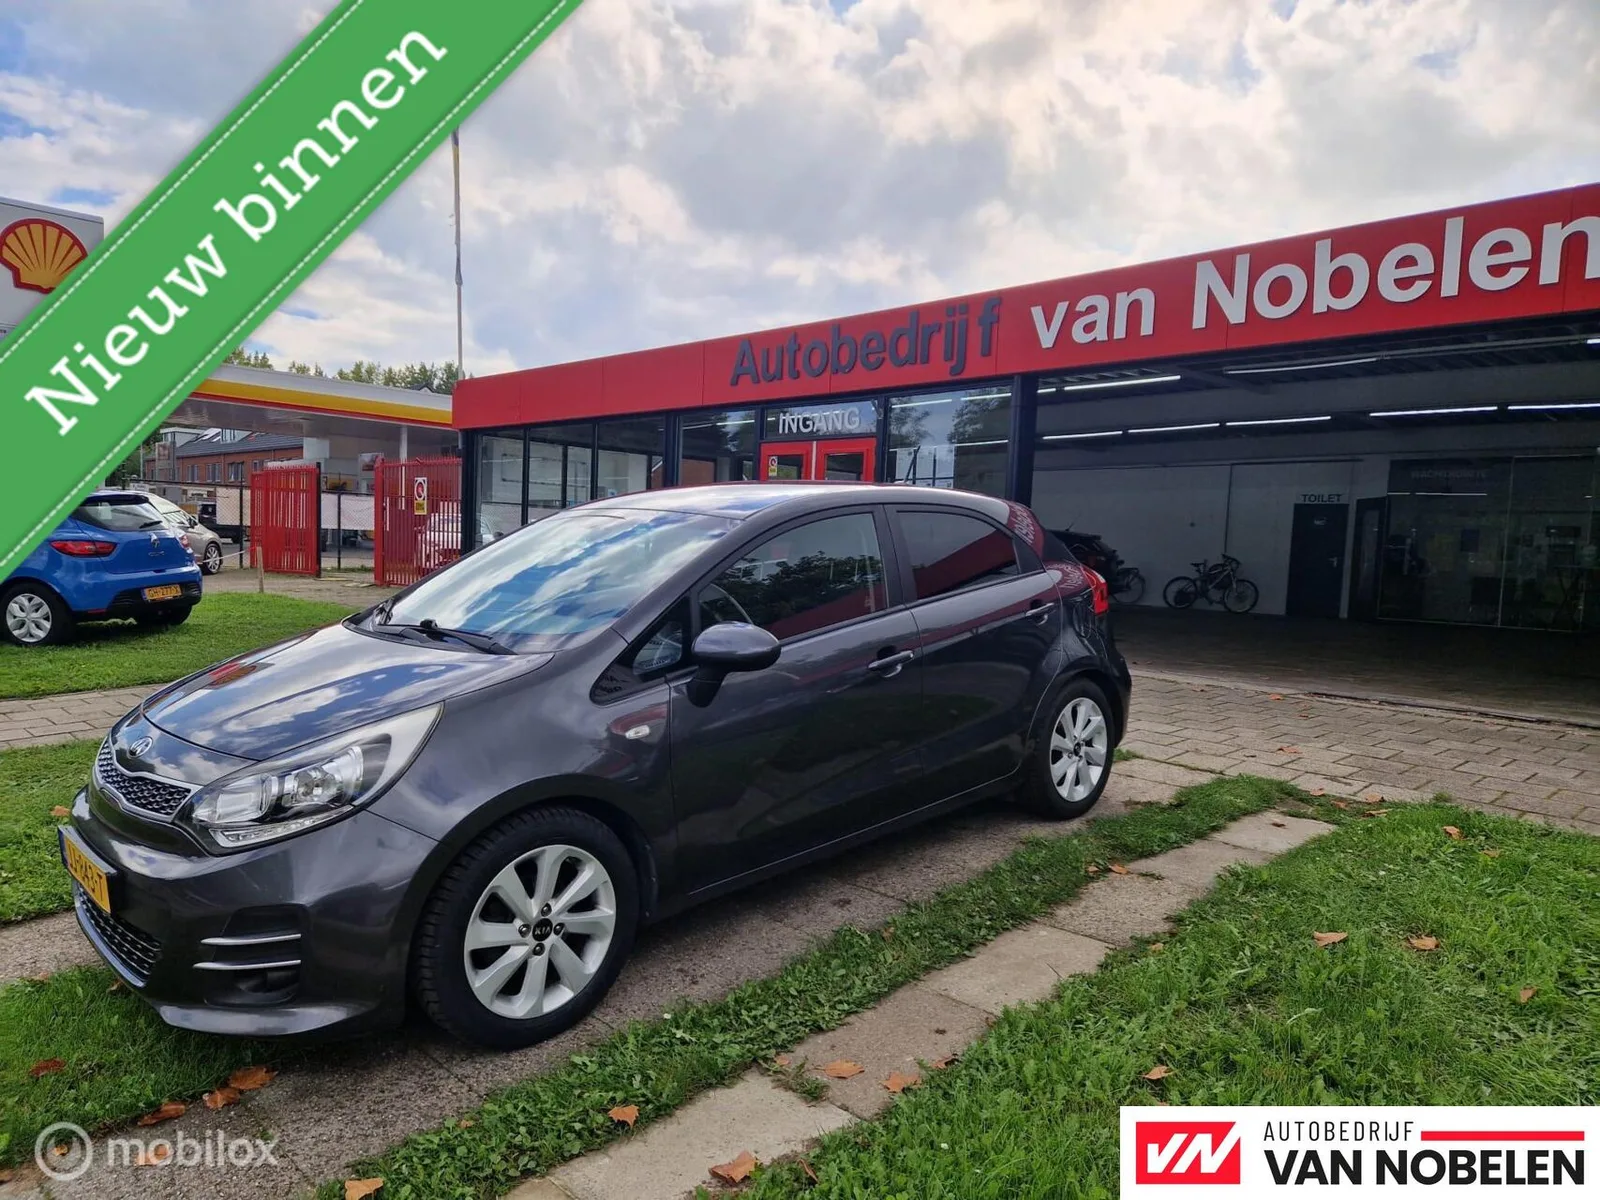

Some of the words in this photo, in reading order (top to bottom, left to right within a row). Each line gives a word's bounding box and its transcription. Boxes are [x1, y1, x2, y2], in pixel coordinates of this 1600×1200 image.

[730, 297, 1002, 387] Autobedrijf
[1031, 288, 1155, 349] van
[1192, 215, 1600, 330] Nobelen
[778, 407, 860, 434] INGANG
[1301, 493, 1343, 503] TOILET
